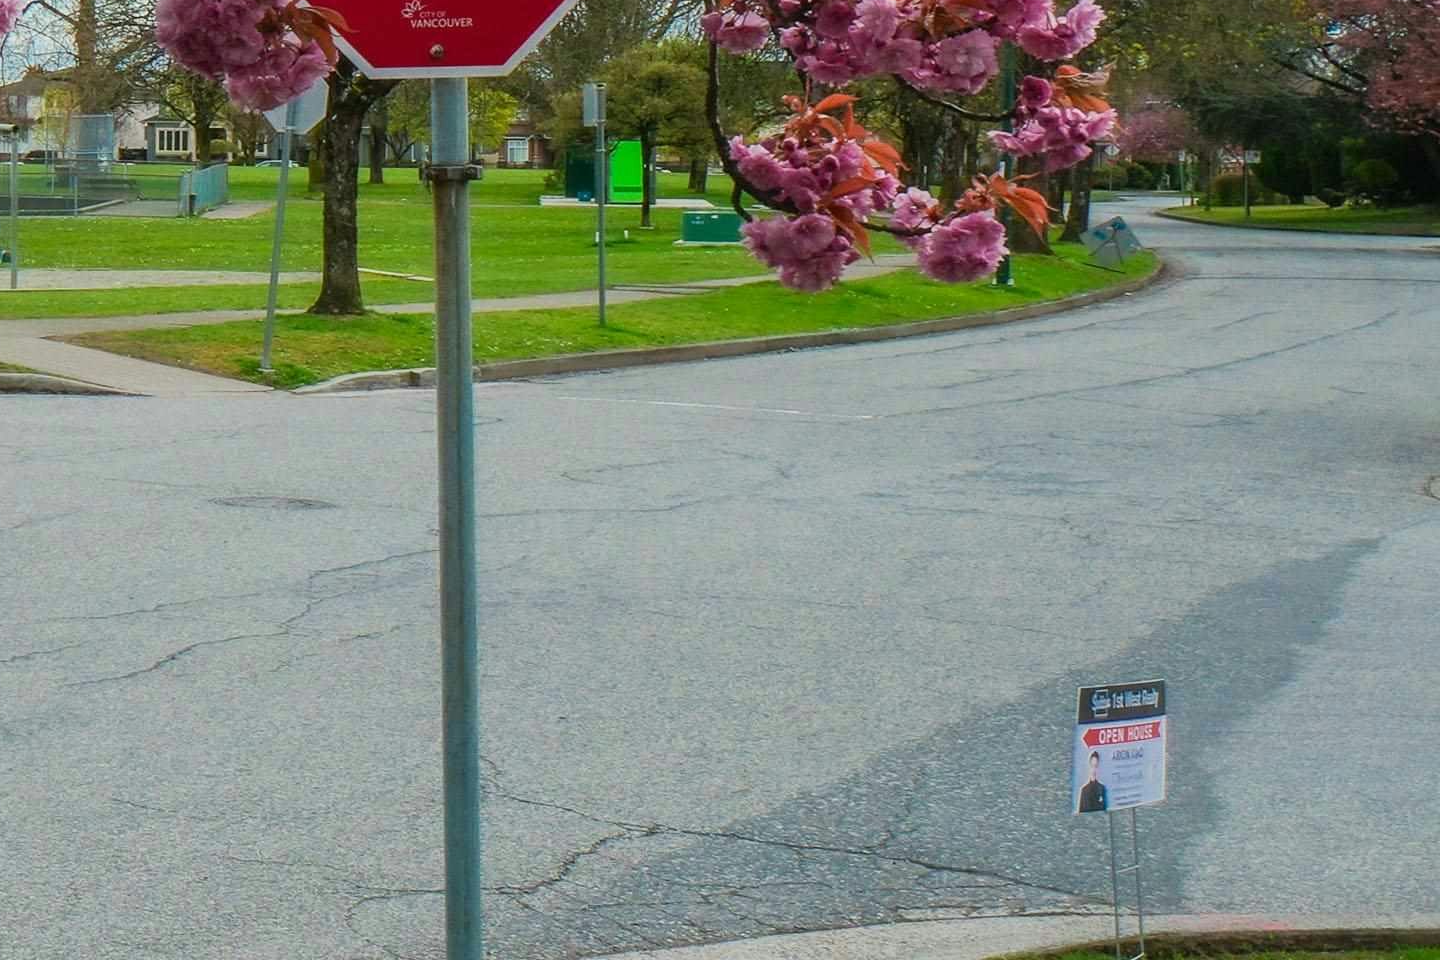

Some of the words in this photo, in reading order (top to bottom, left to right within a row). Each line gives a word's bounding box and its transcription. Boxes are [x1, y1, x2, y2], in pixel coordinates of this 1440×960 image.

[410, 18, 473, 28] VANCOUVER
[1099, 726, 1125, 744] OPEN
[1127, 724, 1154, 741] HOUSE
